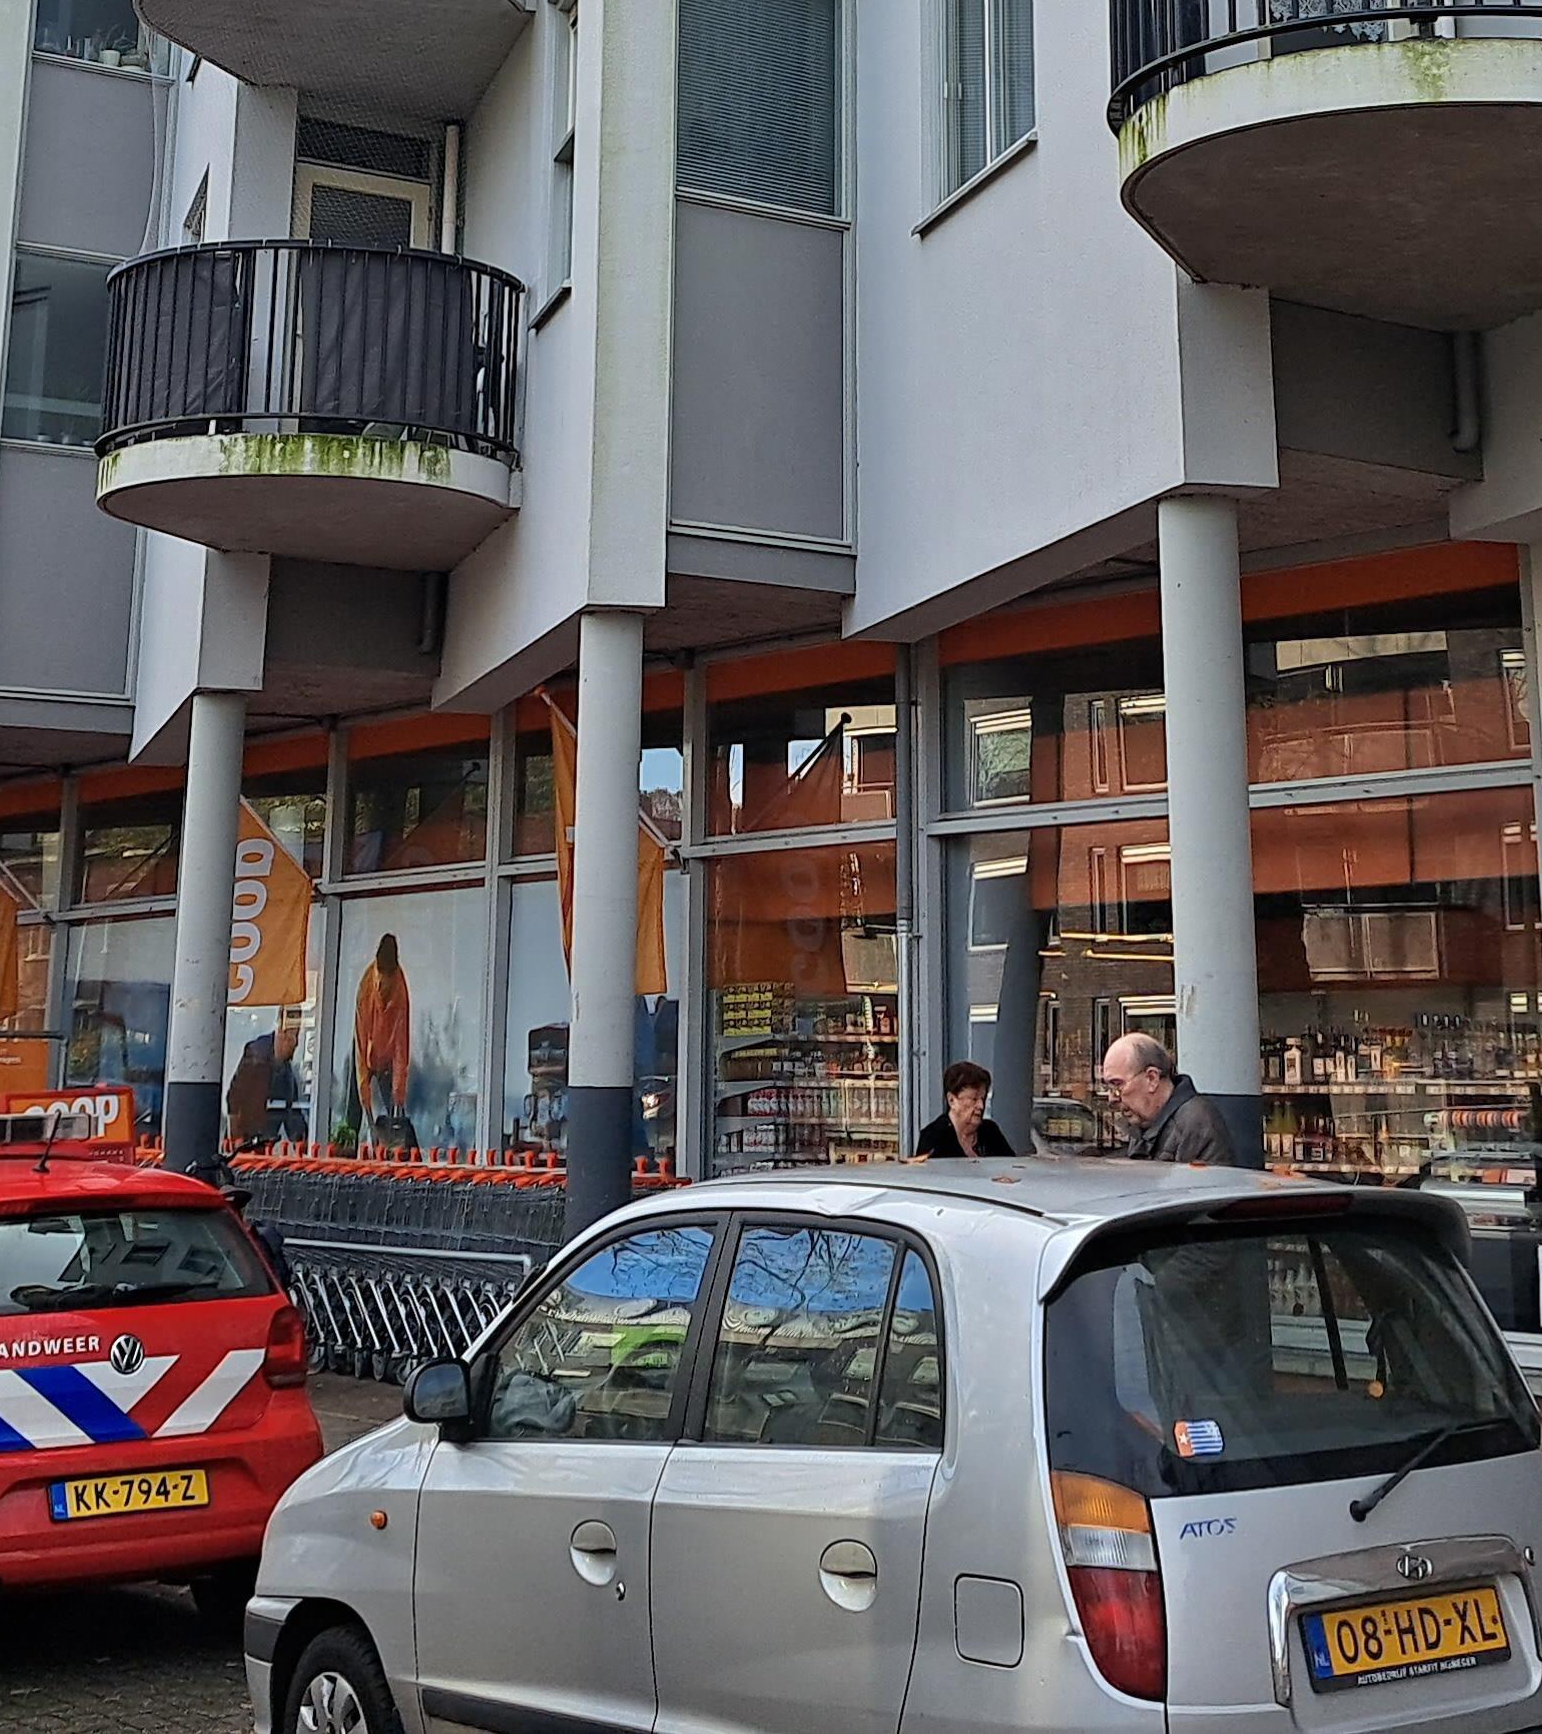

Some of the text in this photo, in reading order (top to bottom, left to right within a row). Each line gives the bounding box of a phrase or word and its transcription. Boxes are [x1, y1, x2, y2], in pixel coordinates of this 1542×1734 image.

[74, 1474, 196, 1512] KK-794-Z
[1179, 1517, 1237, 1540] ATOS
[1336, 1598, 1498, 1664] 08-HD-XL
